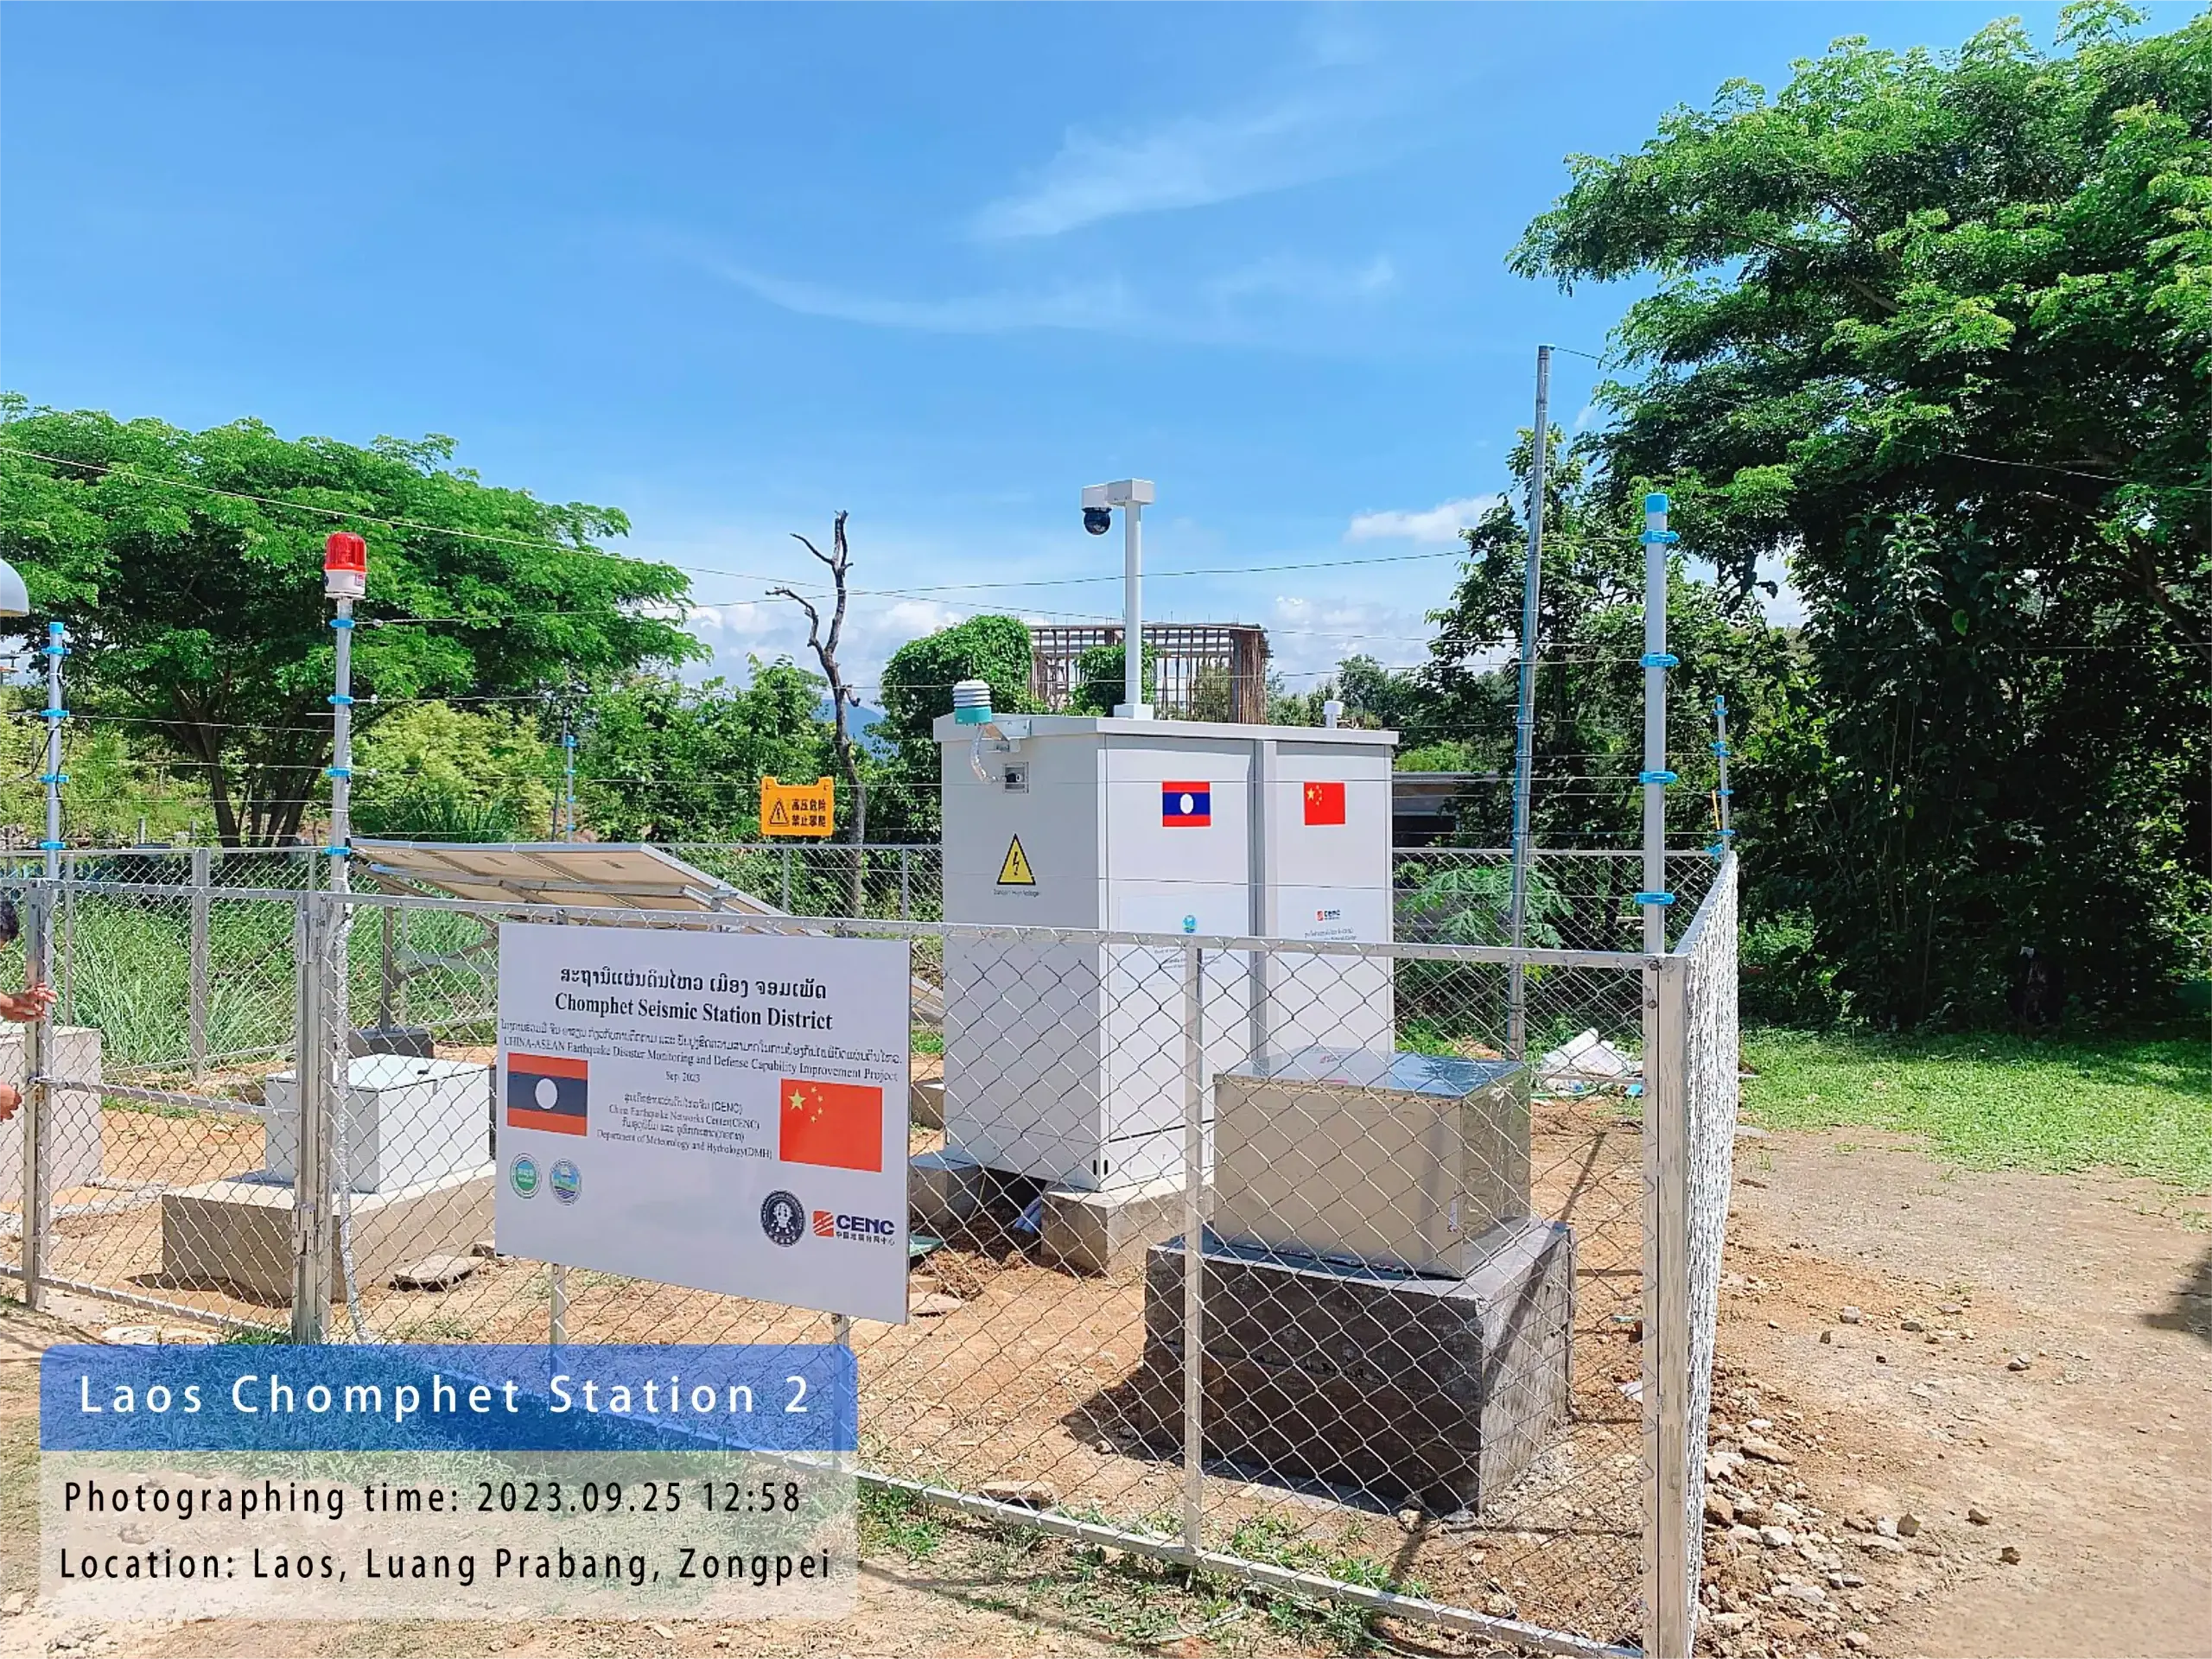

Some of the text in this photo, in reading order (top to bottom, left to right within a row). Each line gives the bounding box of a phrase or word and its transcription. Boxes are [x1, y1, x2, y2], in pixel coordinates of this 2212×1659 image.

[791, 798, 826, 811] 高压危险
[791, 815, 826, 827] 禁止攀爬
[555, 992, 833, 1031] Chomphet Seismic Station District
[567, 1042, 611, 1057] Earthquake
[647, 1050, 694, 1066] Monitoring
[696, 1053, 712, 1065] and
[751, 1058, 797, 1077] Capability
[799, 1063, 861, 1079] Improvement
[863, 1068, 899, 1083] Project
[836, 1214, 895, 1236] CENC
